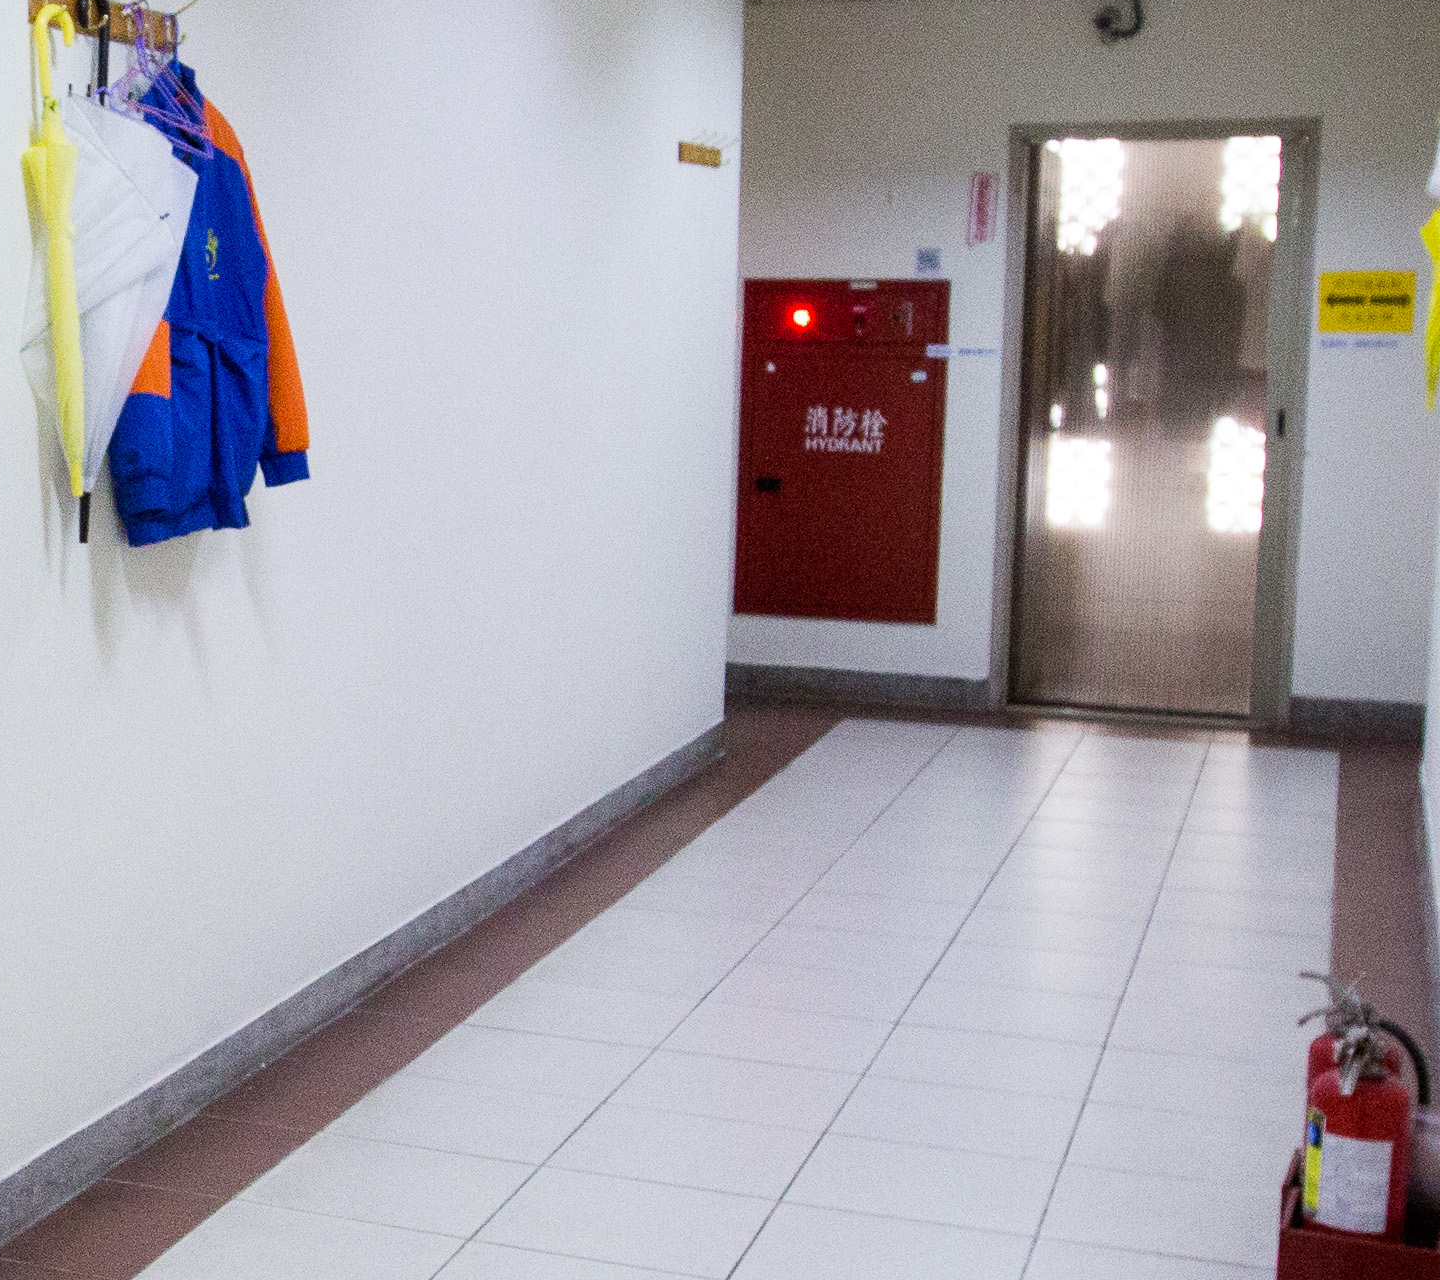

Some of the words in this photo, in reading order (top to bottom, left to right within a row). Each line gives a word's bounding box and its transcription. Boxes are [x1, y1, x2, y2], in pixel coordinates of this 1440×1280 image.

[804, 405, 888, 437] 消防栓
[805, 436, 884, 453] HYDRANT
